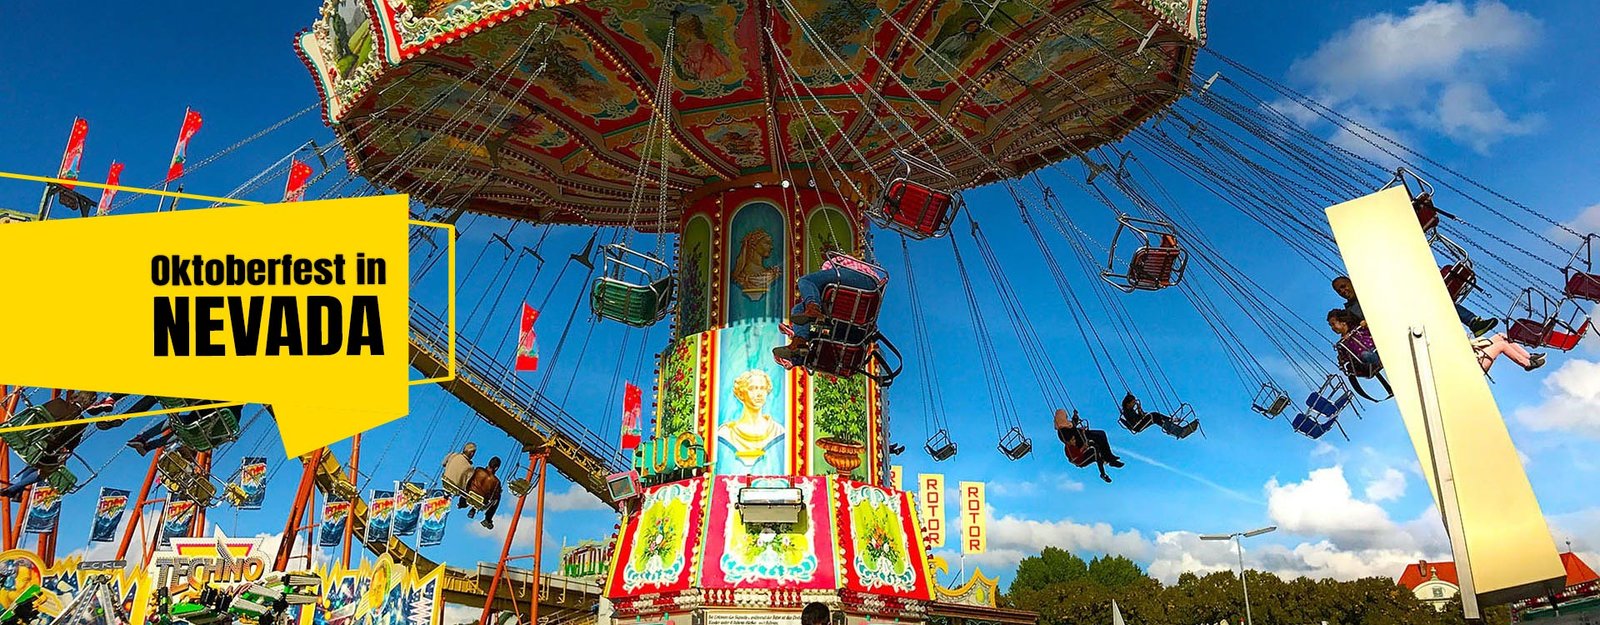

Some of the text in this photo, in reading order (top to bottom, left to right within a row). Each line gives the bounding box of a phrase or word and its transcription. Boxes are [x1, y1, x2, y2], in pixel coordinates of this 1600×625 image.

[926, 479, 940, 544] ROTOR
[967, 487, 981, 550] ROTOR
[156, 557, 265, 595] TECHNO
